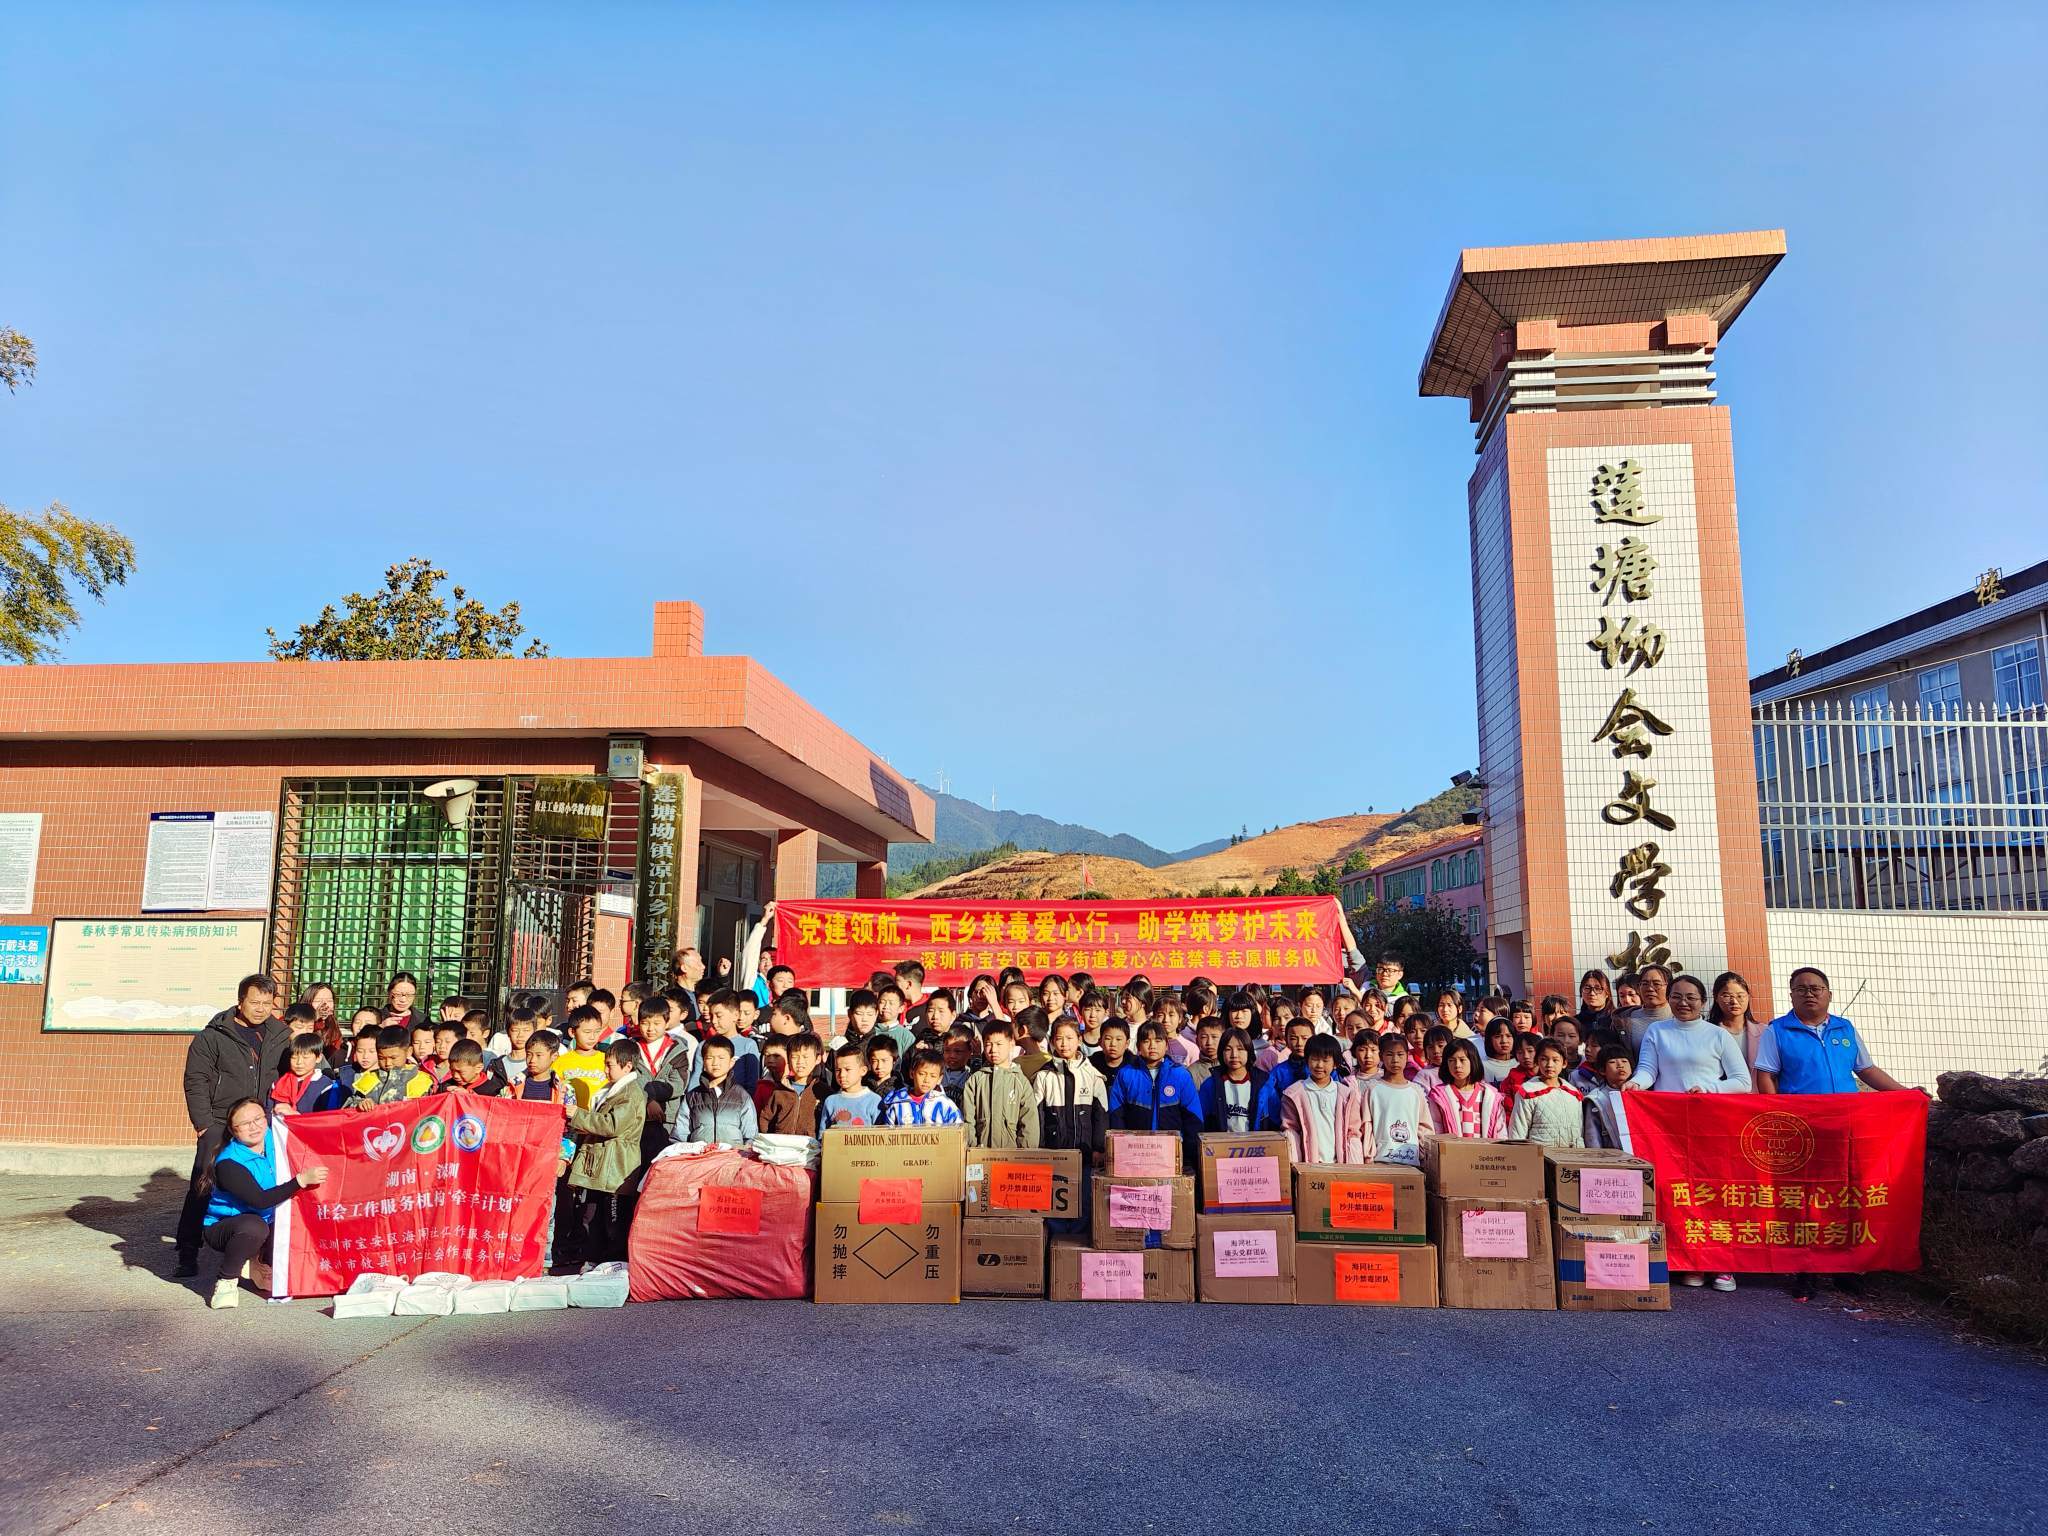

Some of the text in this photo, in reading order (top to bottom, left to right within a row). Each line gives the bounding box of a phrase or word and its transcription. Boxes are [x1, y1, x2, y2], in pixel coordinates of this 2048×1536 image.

[82, 924, 238, 937] 春秋季常见传染病预防知识
[798, 909, 1319, 946] 党建领航，西乡禁毒爱心行，助学筑梦护未来
[1671, 1182, 1888, 1210] 西乡街道爱心公益
[1684, 1219, 1878, 1246] 禁毒志愿服务队
[832, 1224, 848, 1280] 勿抛摔
[924, 1224, 940, 1280] 勿重压
